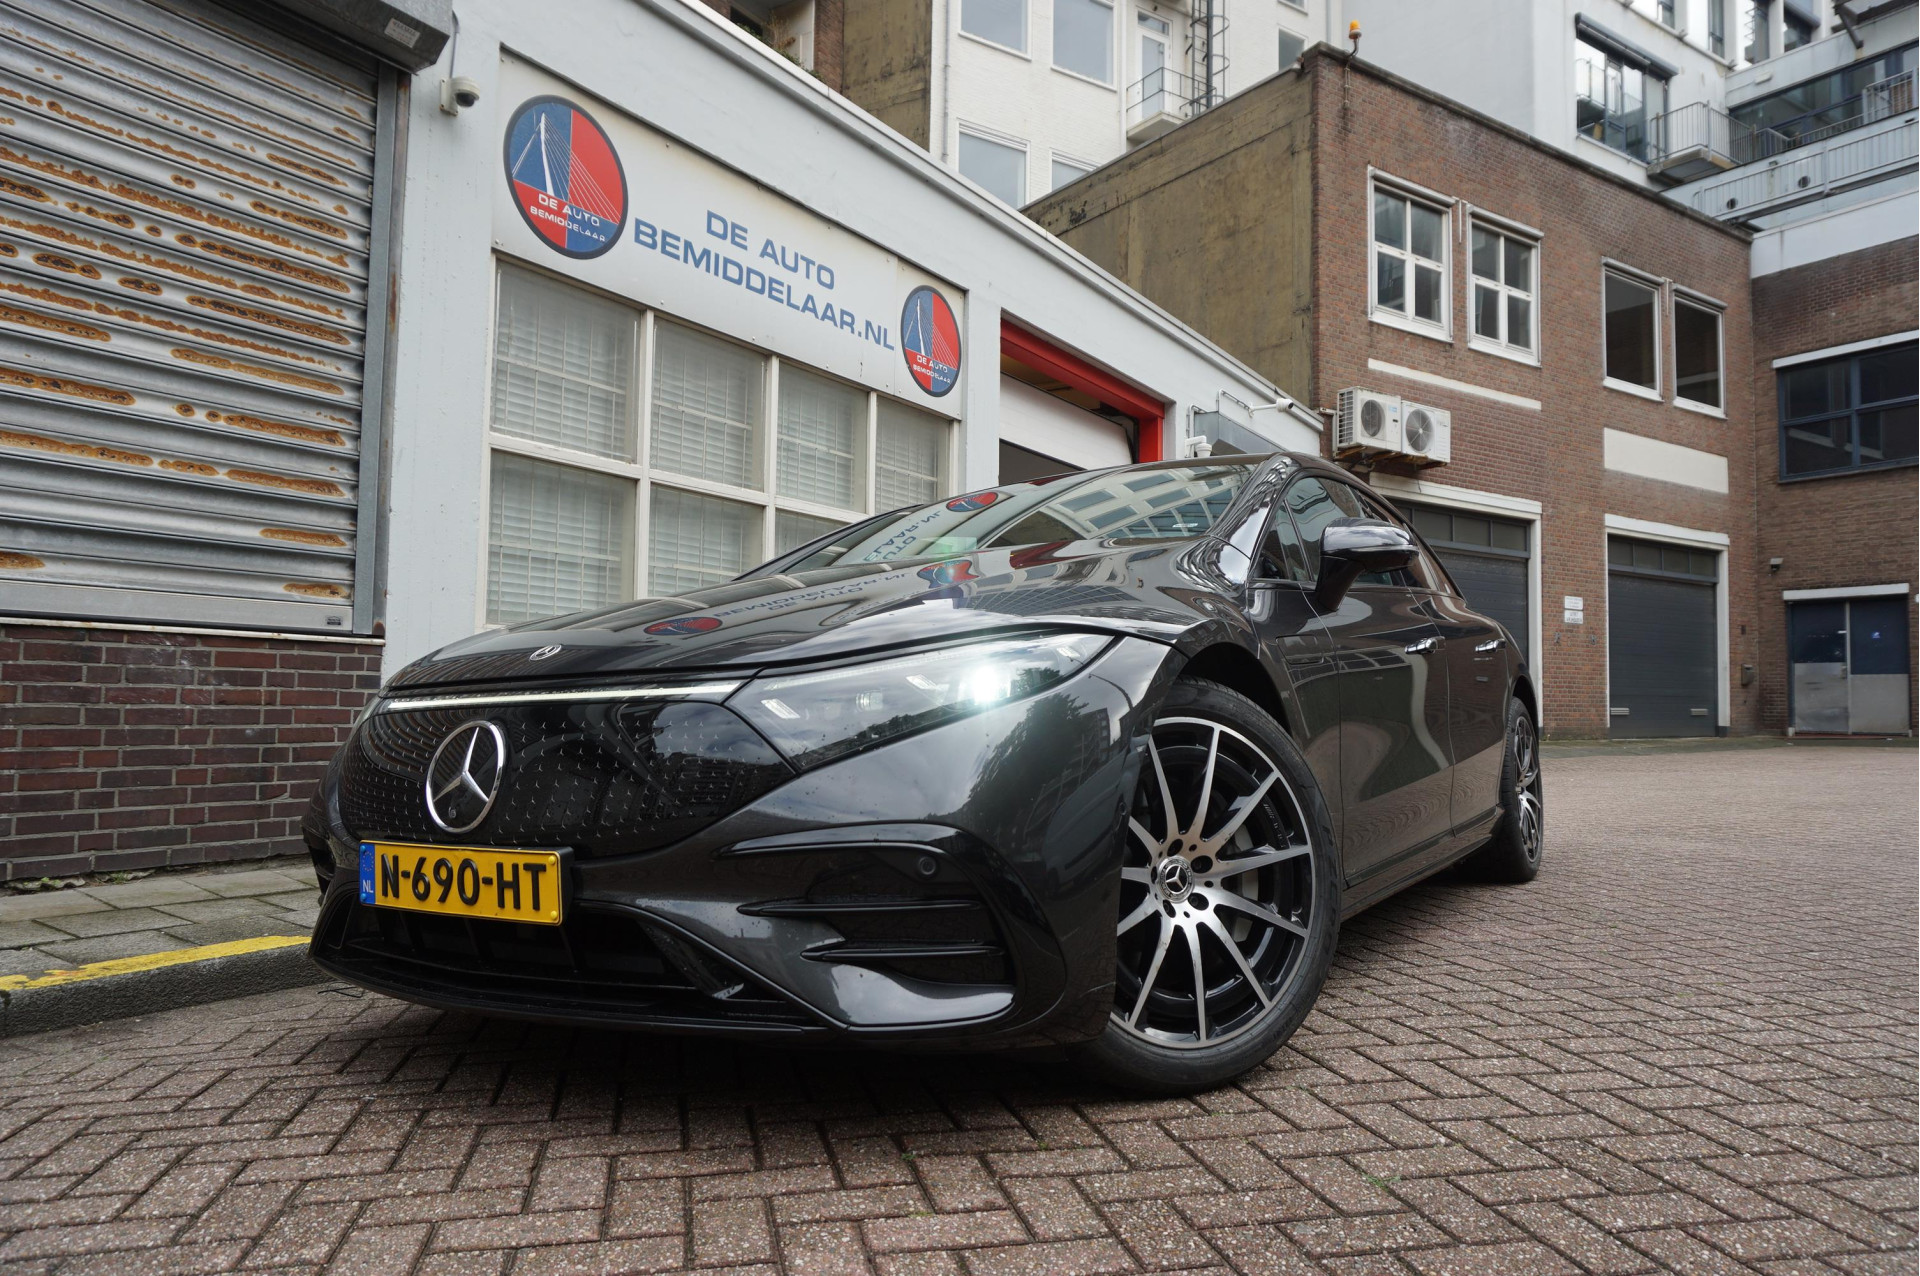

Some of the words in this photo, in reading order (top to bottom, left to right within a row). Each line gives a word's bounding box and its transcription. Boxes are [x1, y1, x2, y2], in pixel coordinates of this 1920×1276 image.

[530, 205, 606, 242] BEMIDDELAAR
[538, 193, 559, 211] DE
[562, 204, 600, 227] AUTO
[706, 209, 748, 251] DE
[759, 238, 835, 290] AUTO
[634, 217, 895, 351] BEMIDDELAAR.NL
[916, 355, 928, 365] DE
[928, 360, 948, 373] AUTO
[362, 880, 374, 894] NL
[381, 853, 547, 911] N-690-HT
